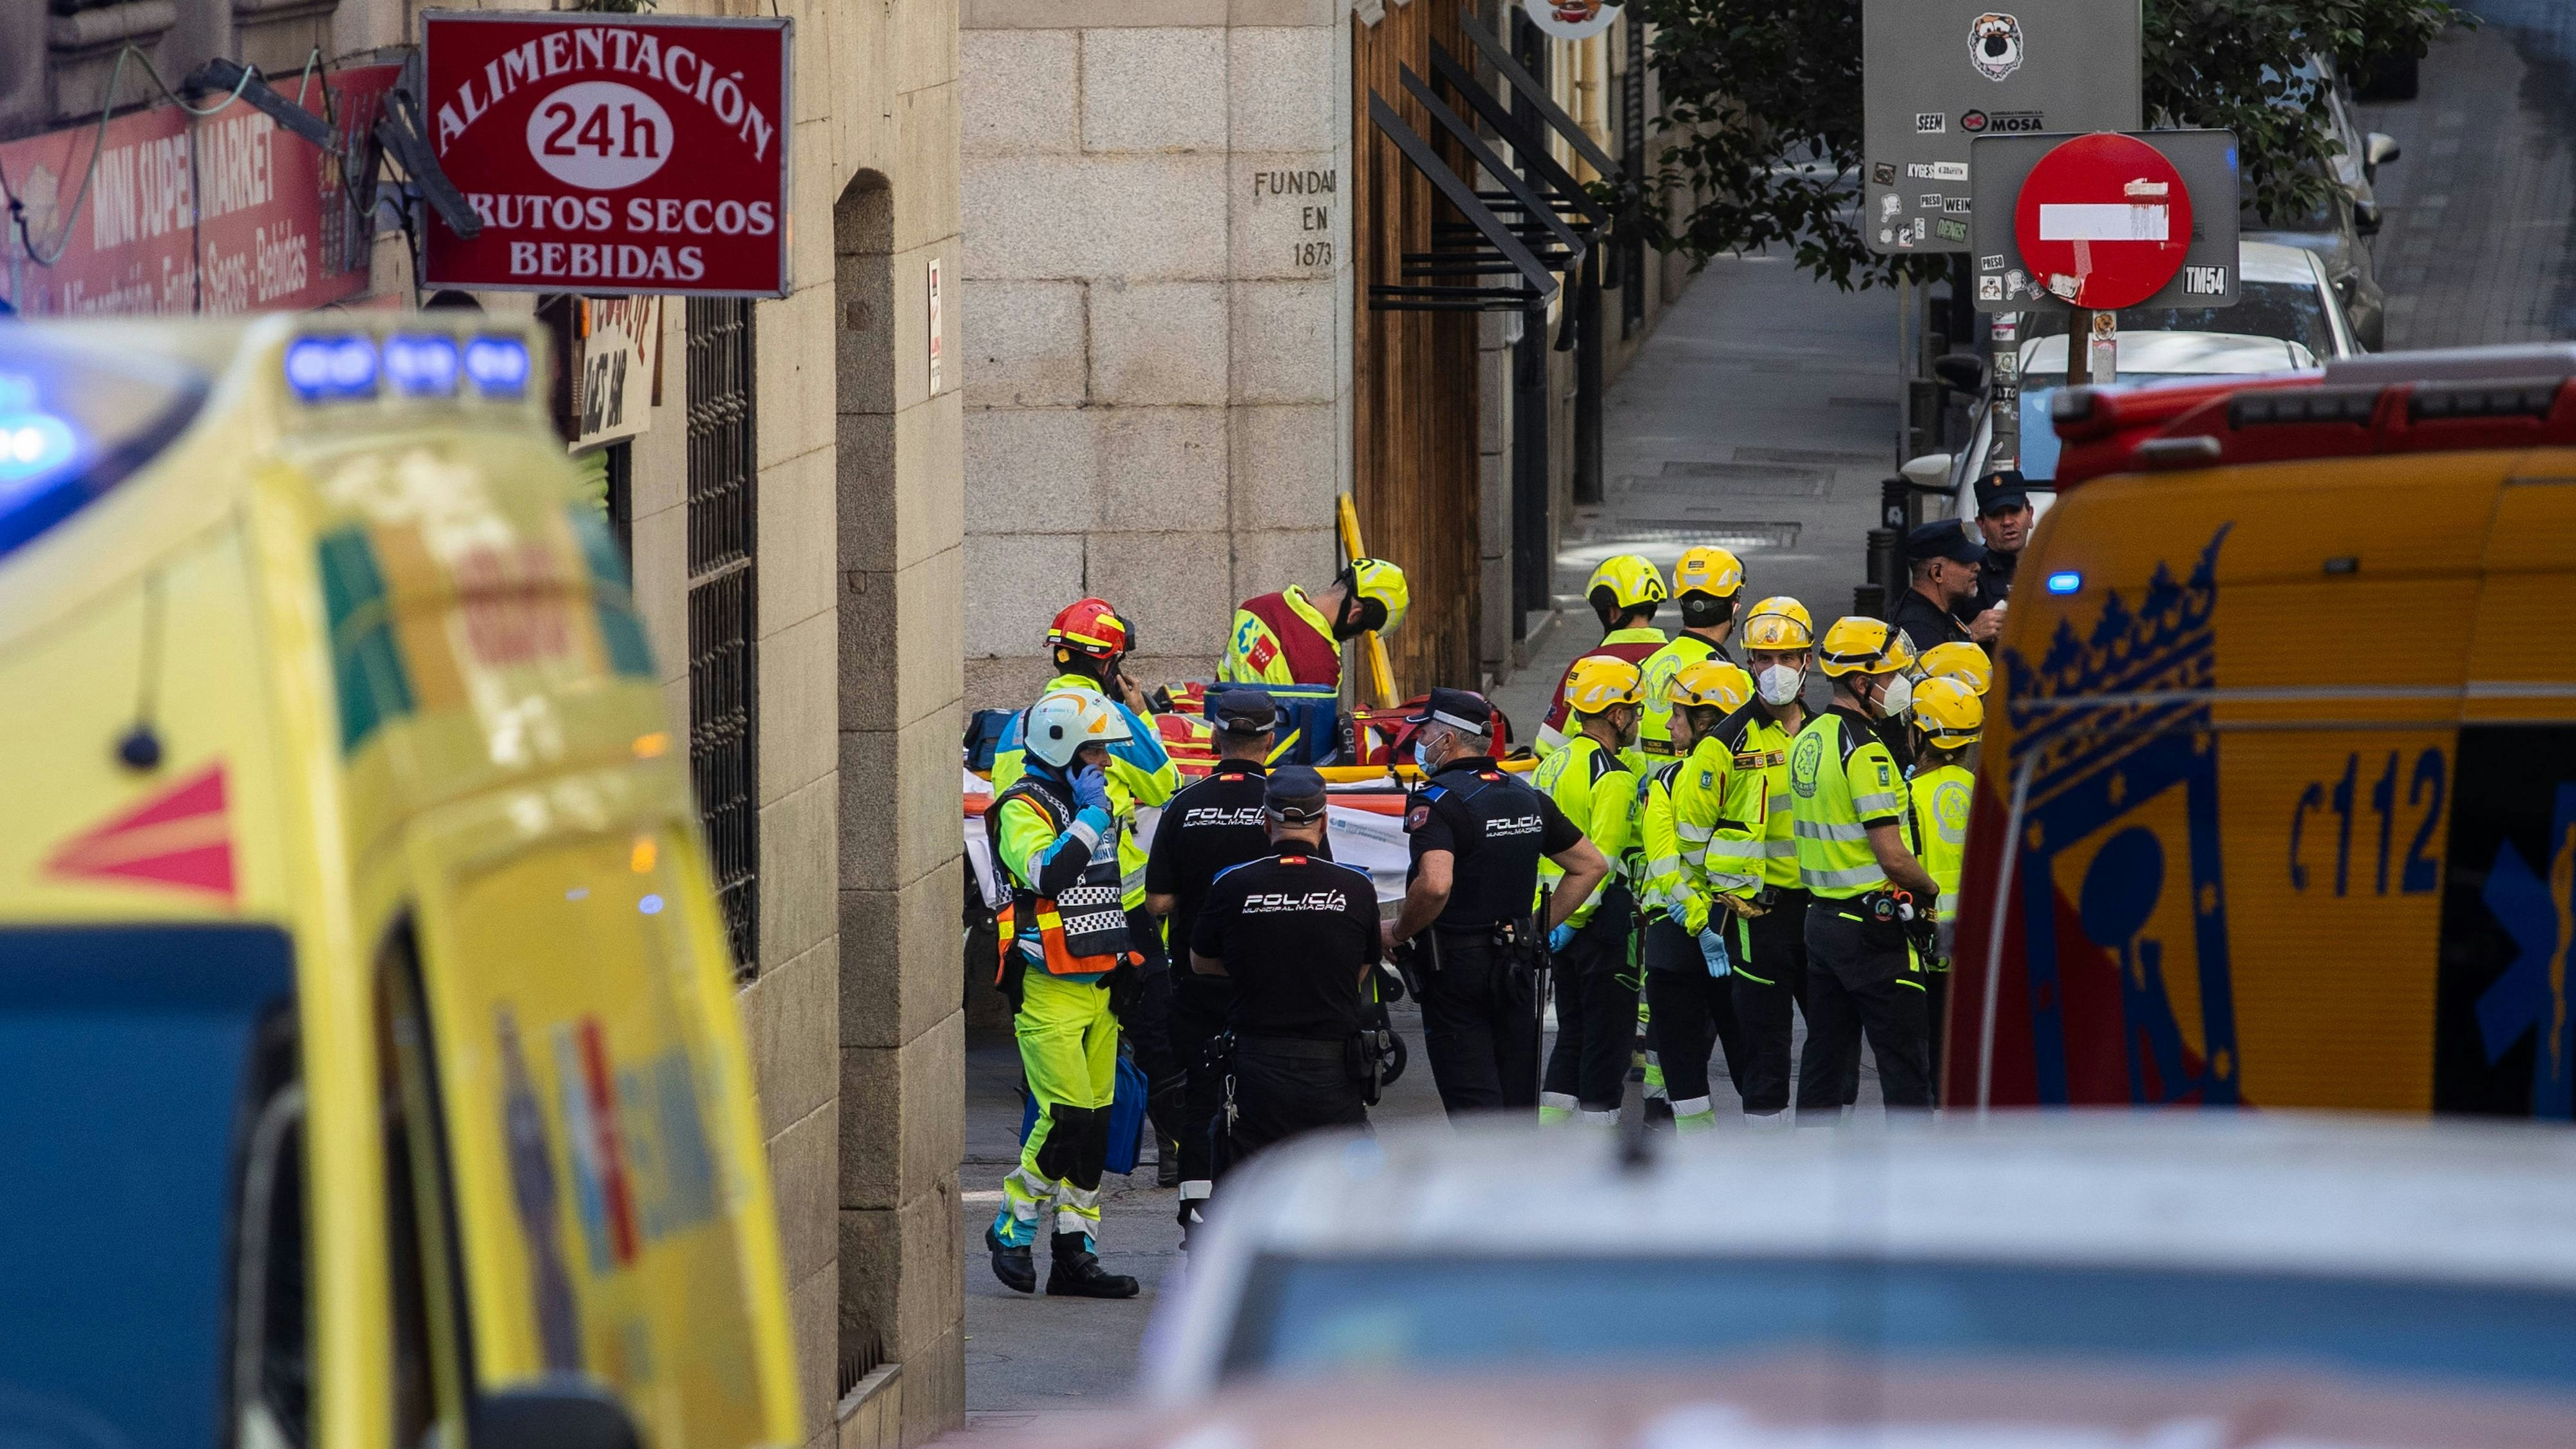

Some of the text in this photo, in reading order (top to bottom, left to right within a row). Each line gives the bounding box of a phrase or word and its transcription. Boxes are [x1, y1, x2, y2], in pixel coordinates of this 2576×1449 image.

[436, 28, 773, 163] ALIMENTACIÓN
[542, 101, 660, 159] 24h
[1918, 115, 1943, 131] SEEM
[1991, 118, 2043, 131] MOSA
[441, 193, 775, 236] RUTOS SECOS
[1303, 205, 1328, 231] EN
[509, 241, 705, 281] BEBIDAS
[1294, 241, 1332, 266] 1873
[2186, 266, 2225, 294] TM54
[1227, 818, 1265, 826] MADRI
[1244, 888, 1347, 907] POLICÍA
[1295, 904, 1345, 912] MADRID
